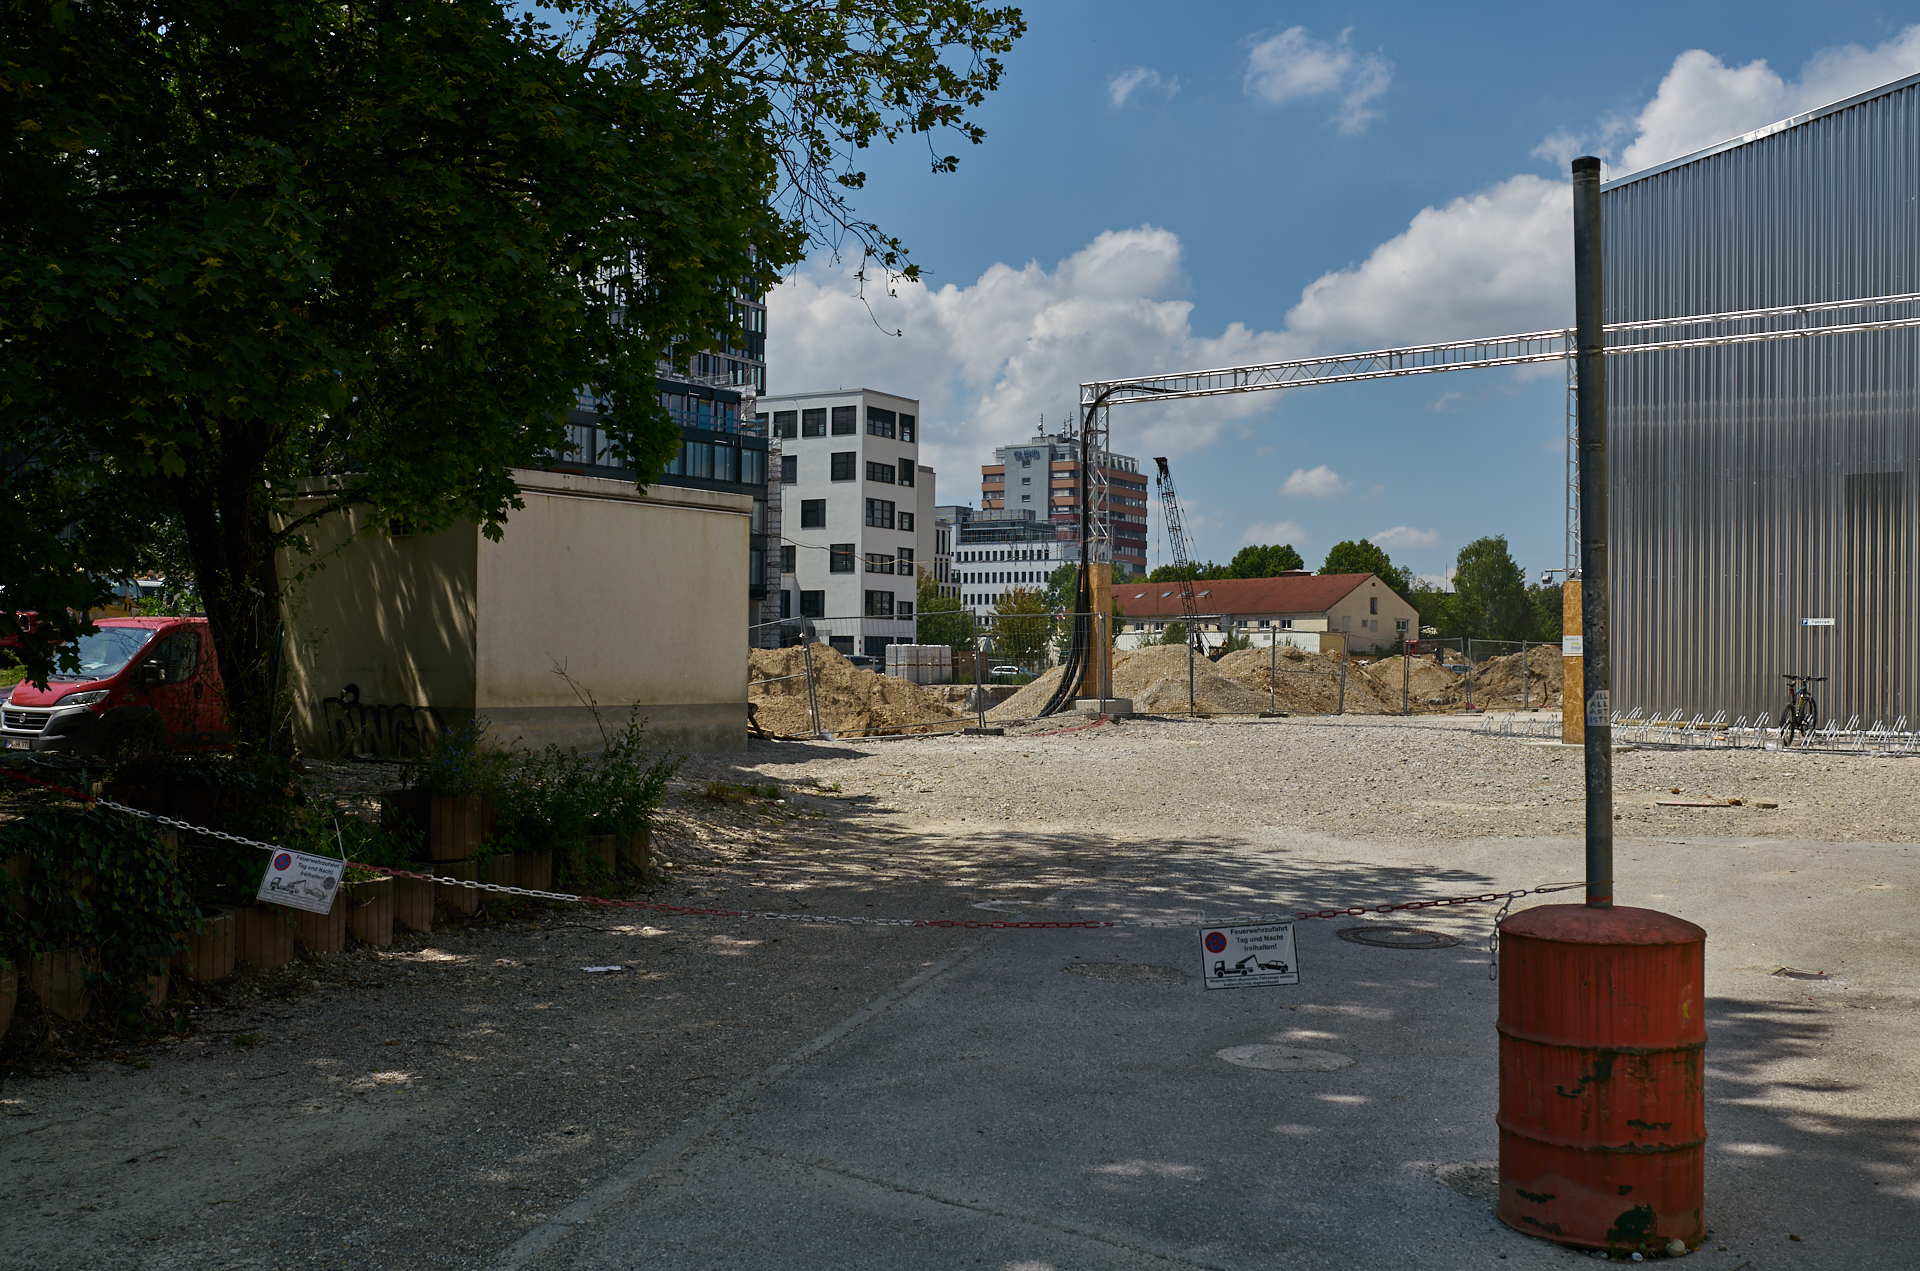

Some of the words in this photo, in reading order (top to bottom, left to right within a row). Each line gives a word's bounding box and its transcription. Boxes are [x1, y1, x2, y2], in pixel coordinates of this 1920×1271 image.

[1594, 692, 1608, 700] ILL
[296, 855, 340, 868] Feuerwehrzufahrt
[298, 862, 307, 870] Tag
[318, 867, 333, 875] Nacht
[300, 870, 326, 880] freihalten!
[1230, 925, 1288, 935] Feuerwehrzufahrt
[1244, 943, 1277, 951] freihalten!
